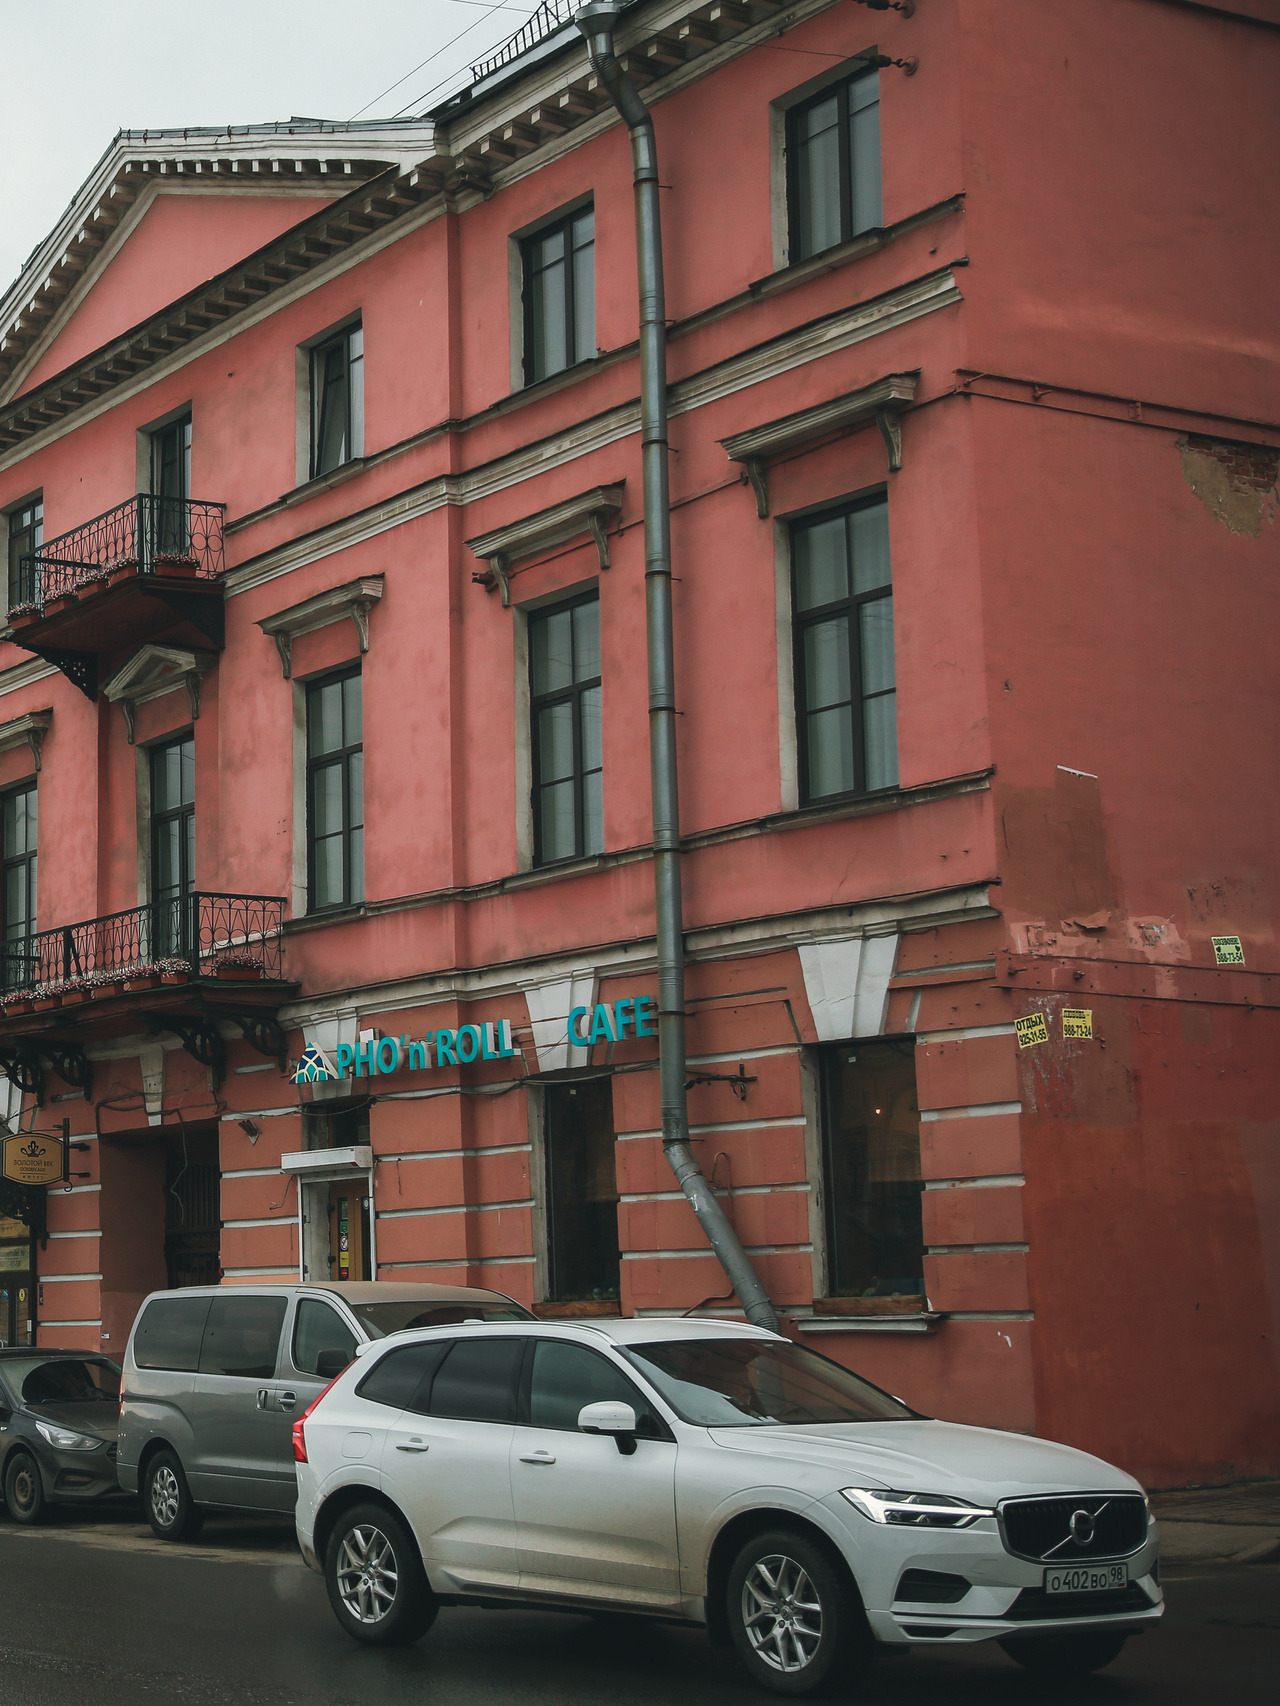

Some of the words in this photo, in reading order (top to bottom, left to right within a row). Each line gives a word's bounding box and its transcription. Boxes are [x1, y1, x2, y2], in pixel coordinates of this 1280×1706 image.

[567, 994, 656, 1048] CAFE
[1016, 1014, 1044, 1032] ОТДЫХ
[13, 1159, 43, 1167] ЗОЛОТОЙ
[43, 1160, 54, 1168] ВЕК
[1051, 1569, 1108, 1591] О402ВО
[1110, 1566, 1123, 1582] 98
